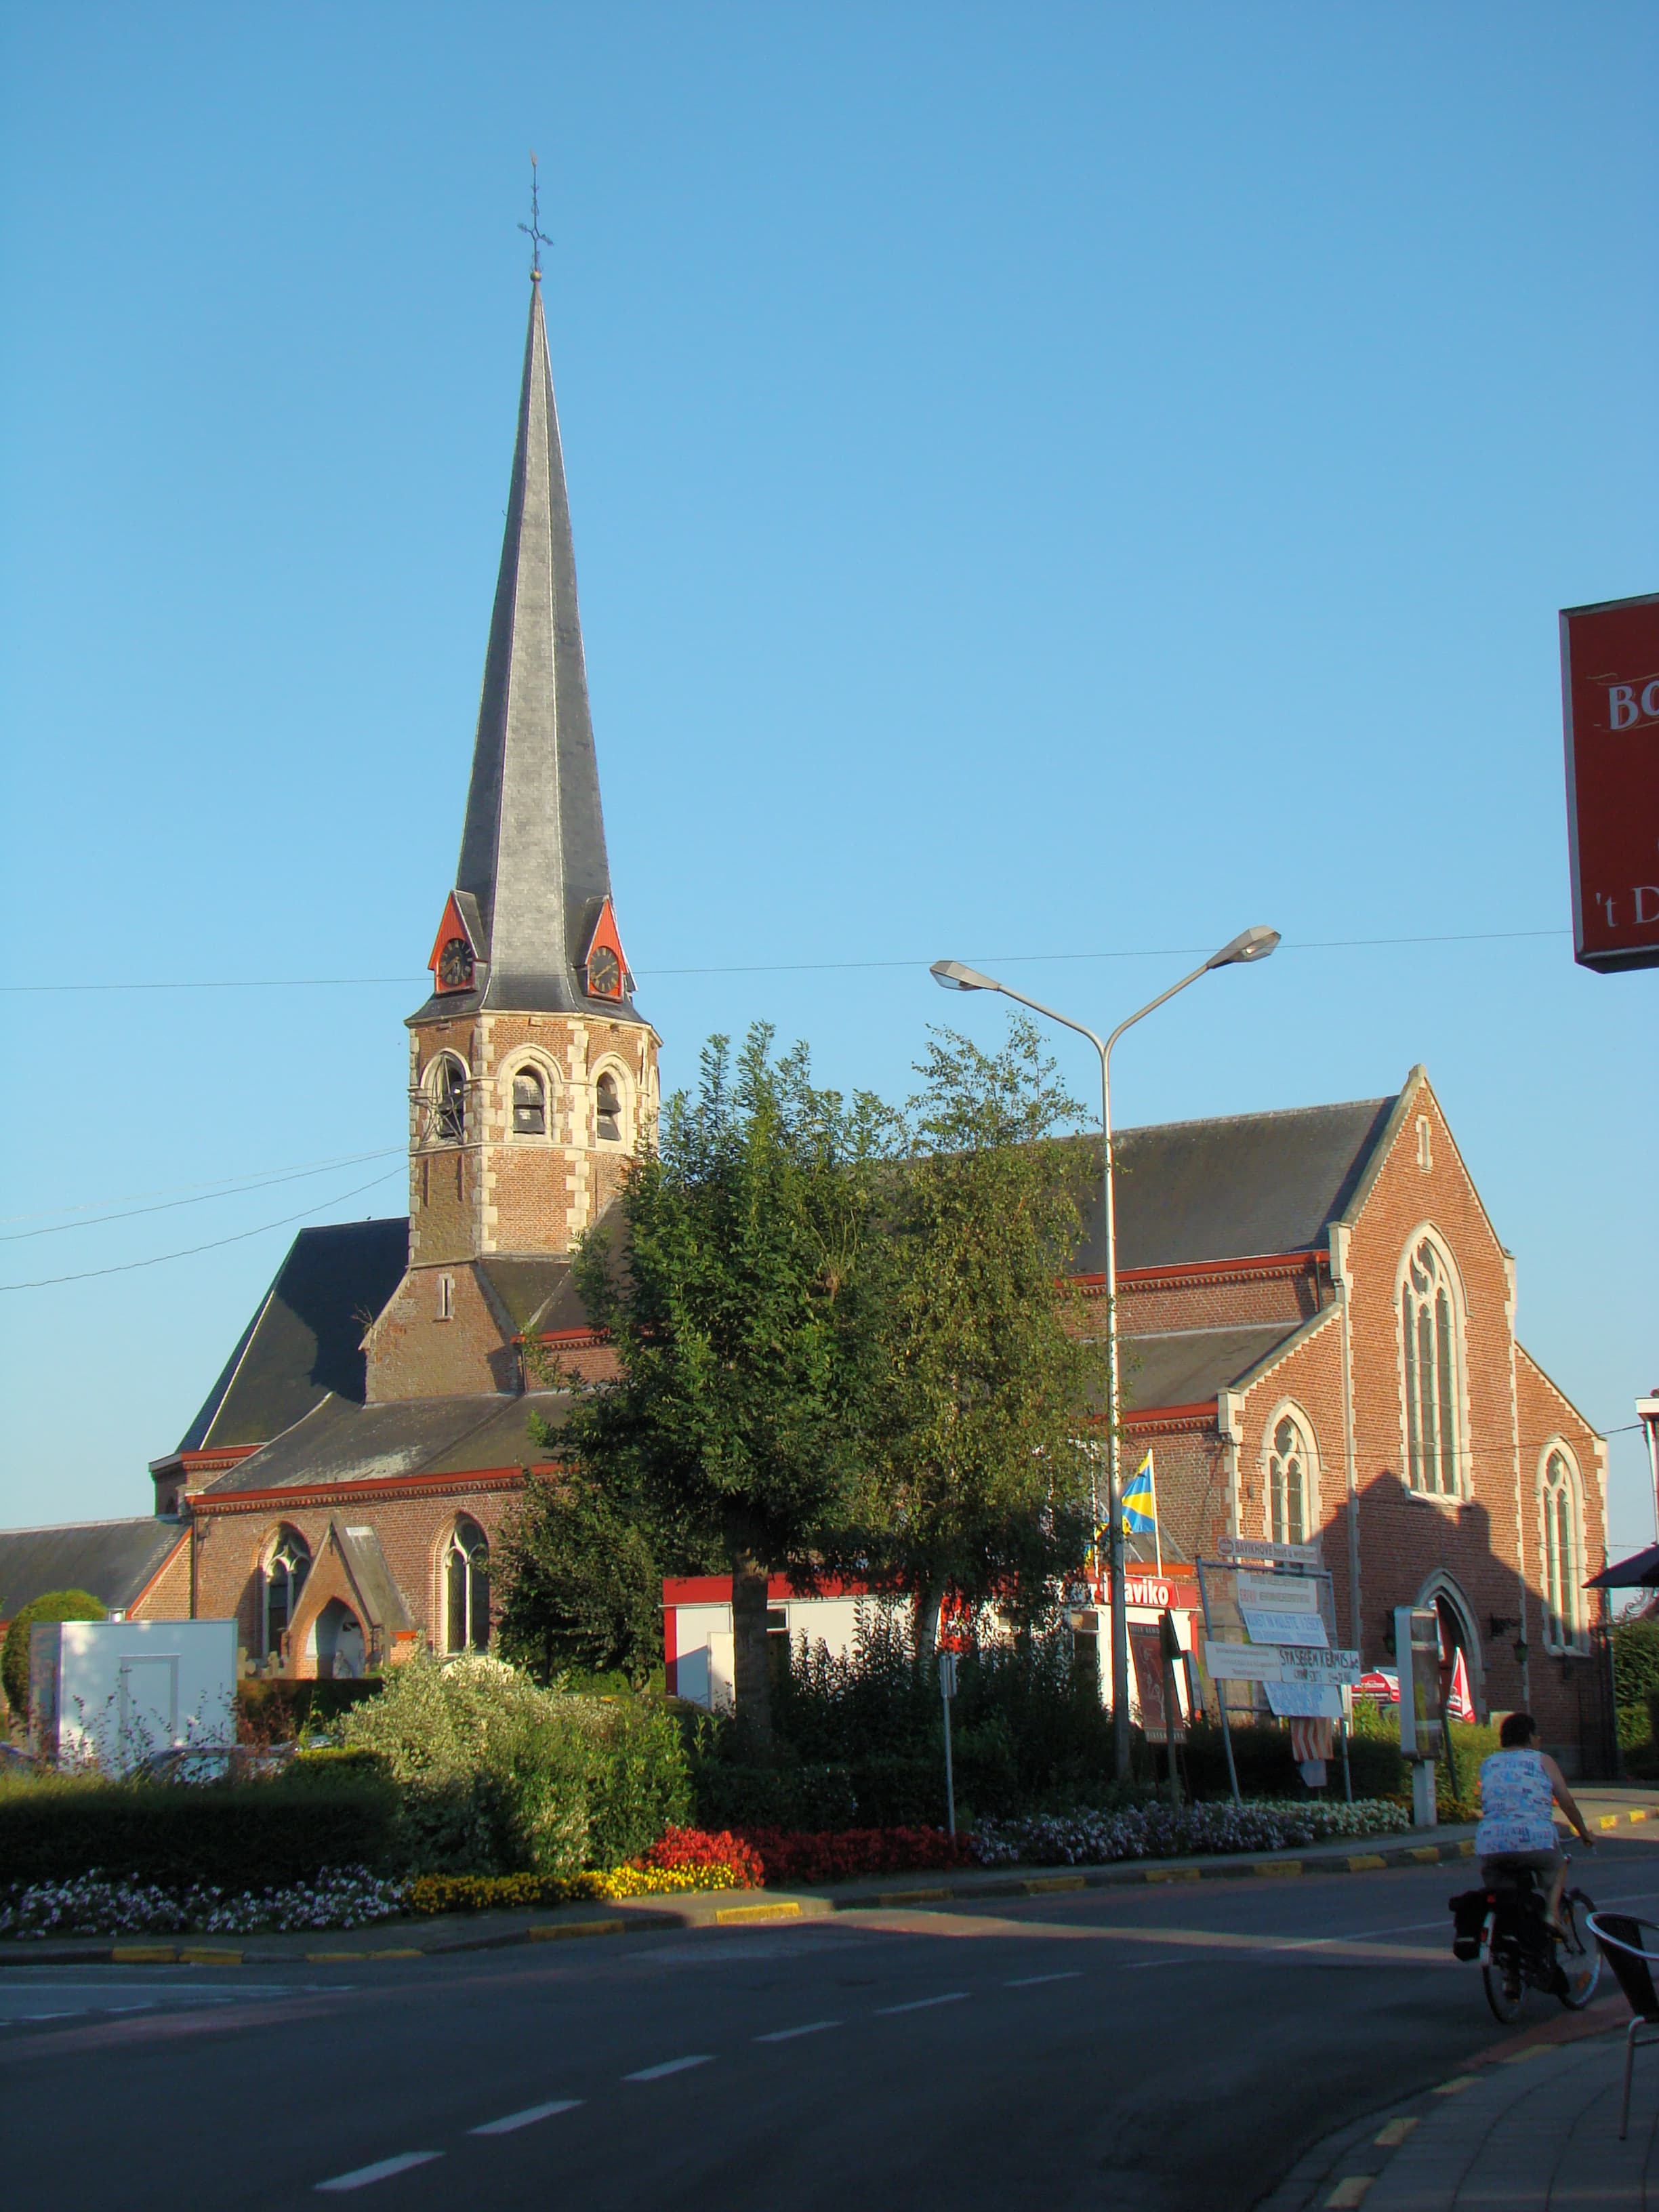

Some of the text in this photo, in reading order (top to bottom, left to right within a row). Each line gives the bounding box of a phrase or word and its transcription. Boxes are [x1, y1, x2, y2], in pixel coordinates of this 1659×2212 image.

[1595, 892, 1618, 928] 't
[1235, 1539, 1273, 1556] BAVIKHOVE
[1124, 1579, 1169, 1605] aviko
